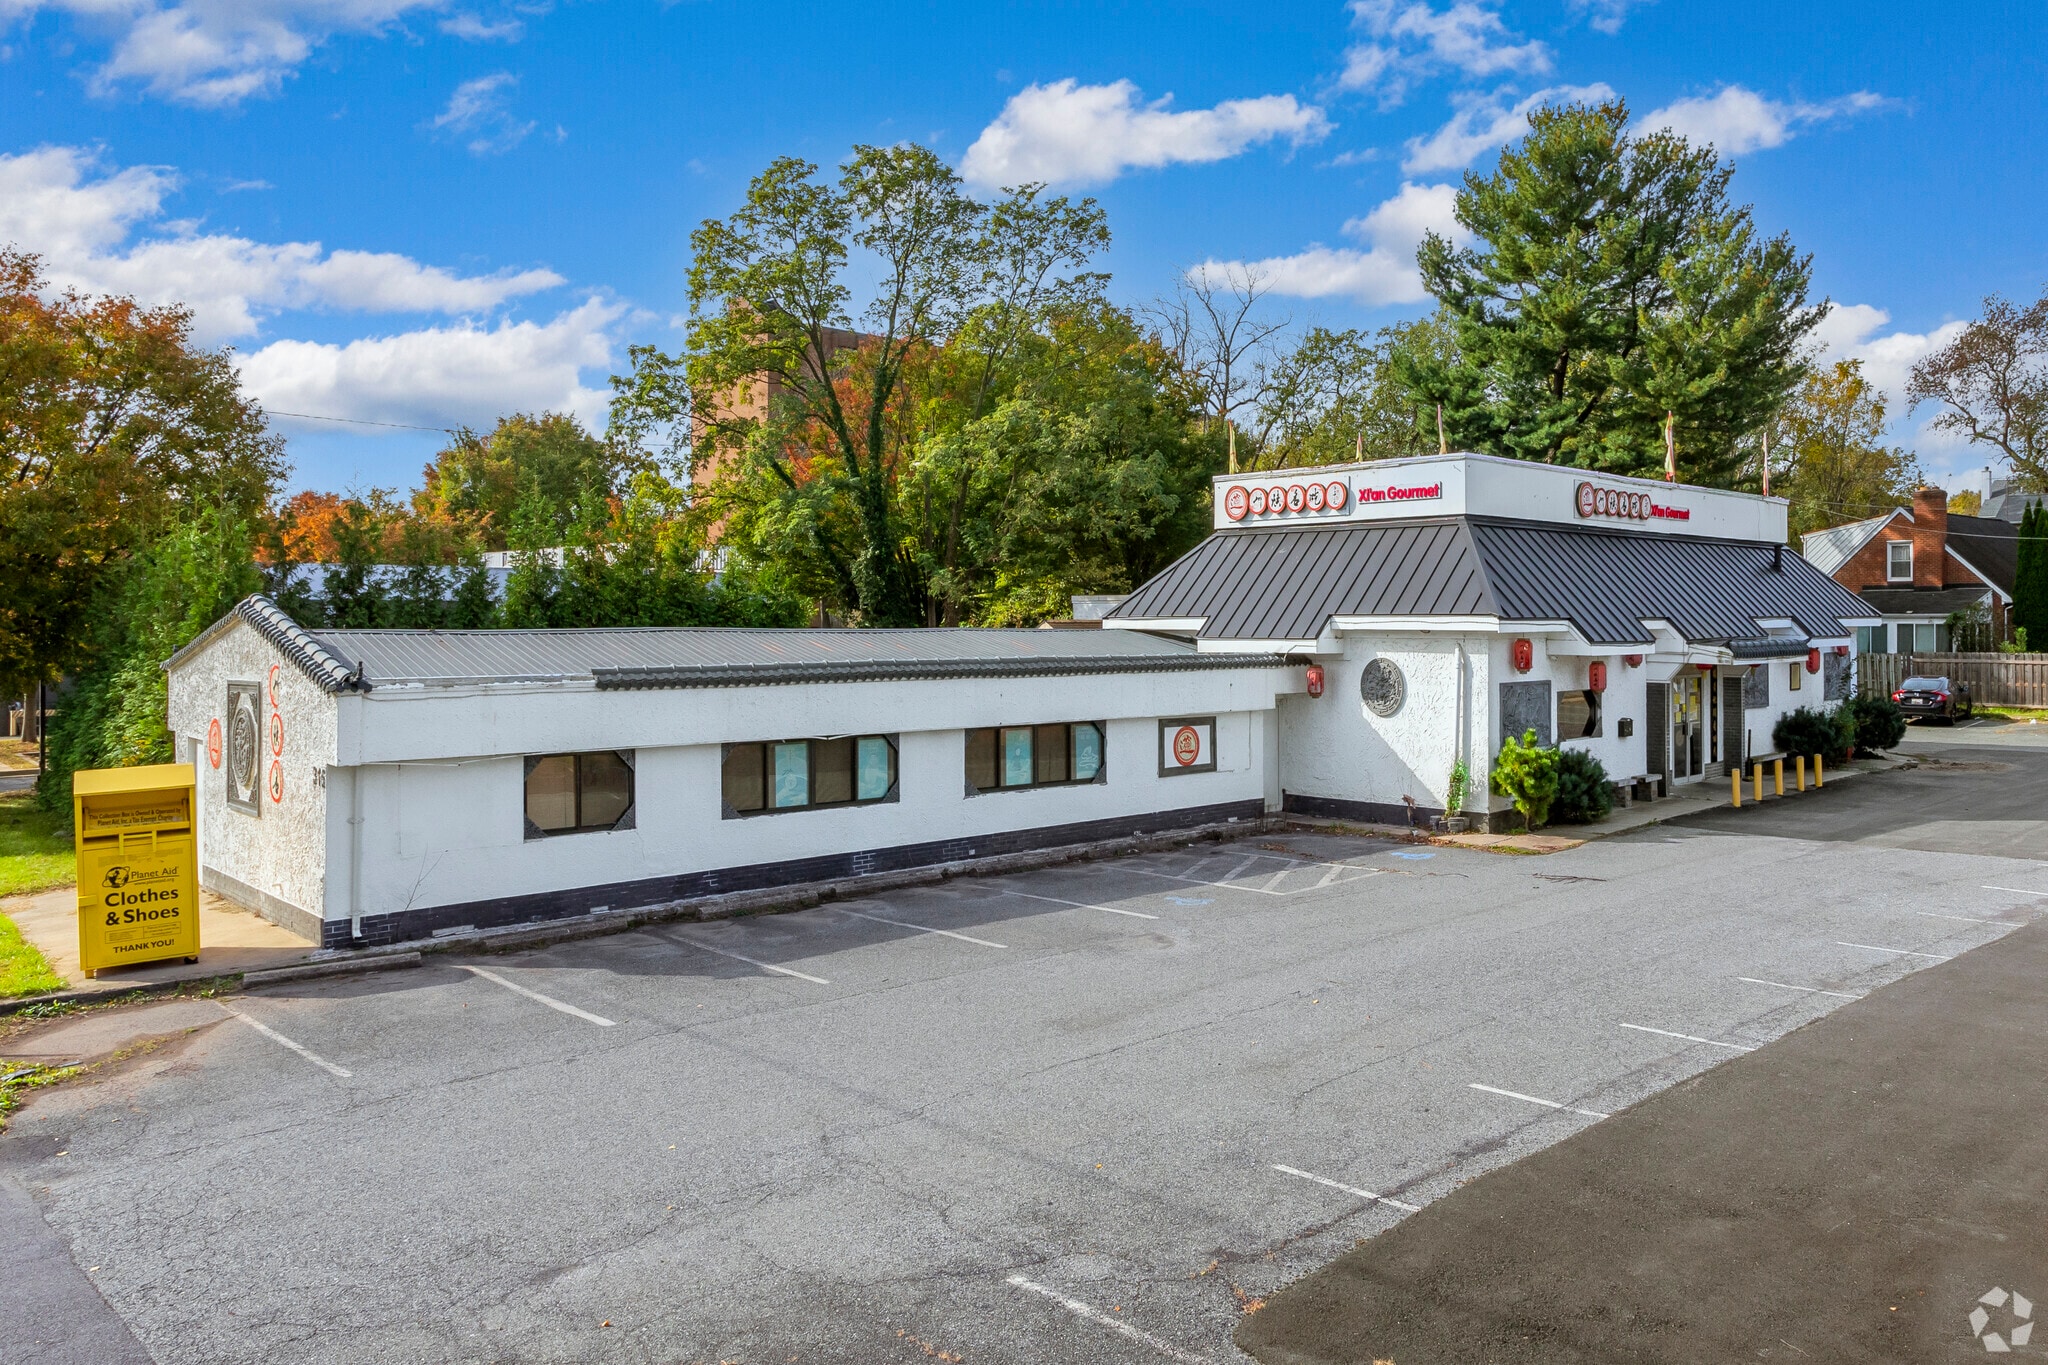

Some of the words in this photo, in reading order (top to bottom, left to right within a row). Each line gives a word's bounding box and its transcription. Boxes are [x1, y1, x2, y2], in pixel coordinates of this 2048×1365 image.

[1387, 483, 1440, 500] Gourmet
[131, 870, 159, 879] Planet
[162, 867, 177, 876] Aid
[104, 888, 179, 907] Clothes
[105, 911, 120, 926] &
[123, 907, 180, 923] Shoes
[113, 942, 150, 953] THANK
[151, 939, 175, 948] YOU!
